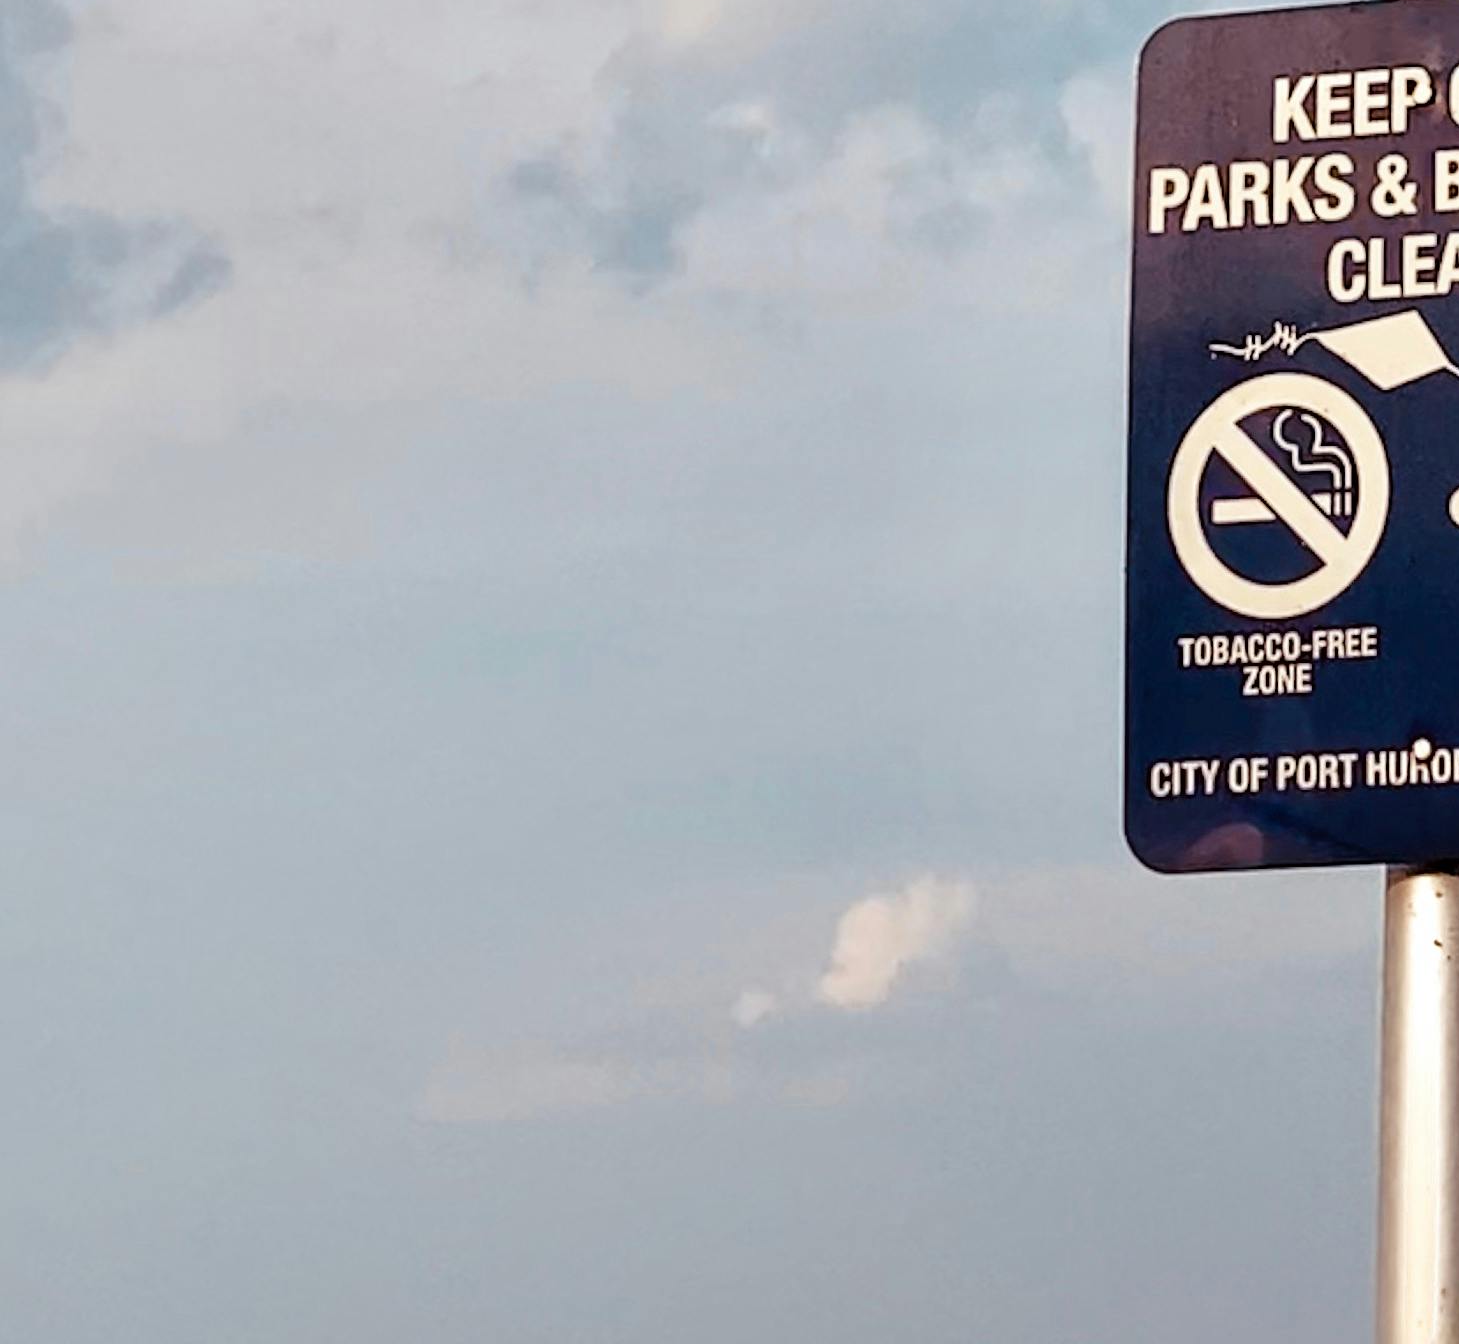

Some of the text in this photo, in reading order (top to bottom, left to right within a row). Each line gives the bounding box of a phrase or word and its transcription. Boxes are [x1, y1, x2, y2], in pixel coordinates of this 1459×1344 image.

[1272, 66, 1433, 144] KEEP
[1147, 152, 1356, 234] PARKS
[1371, 153, 1418, 218] &
[1177, 626, 1378, 668] TOBACCO-FREE
[1242, 663, 1313, 696] ZONE
[1150, 759, 1221, 798] CITY
[1228, 756, 1270, 794] OF
[1276, 752, 1359, 792] PORT
